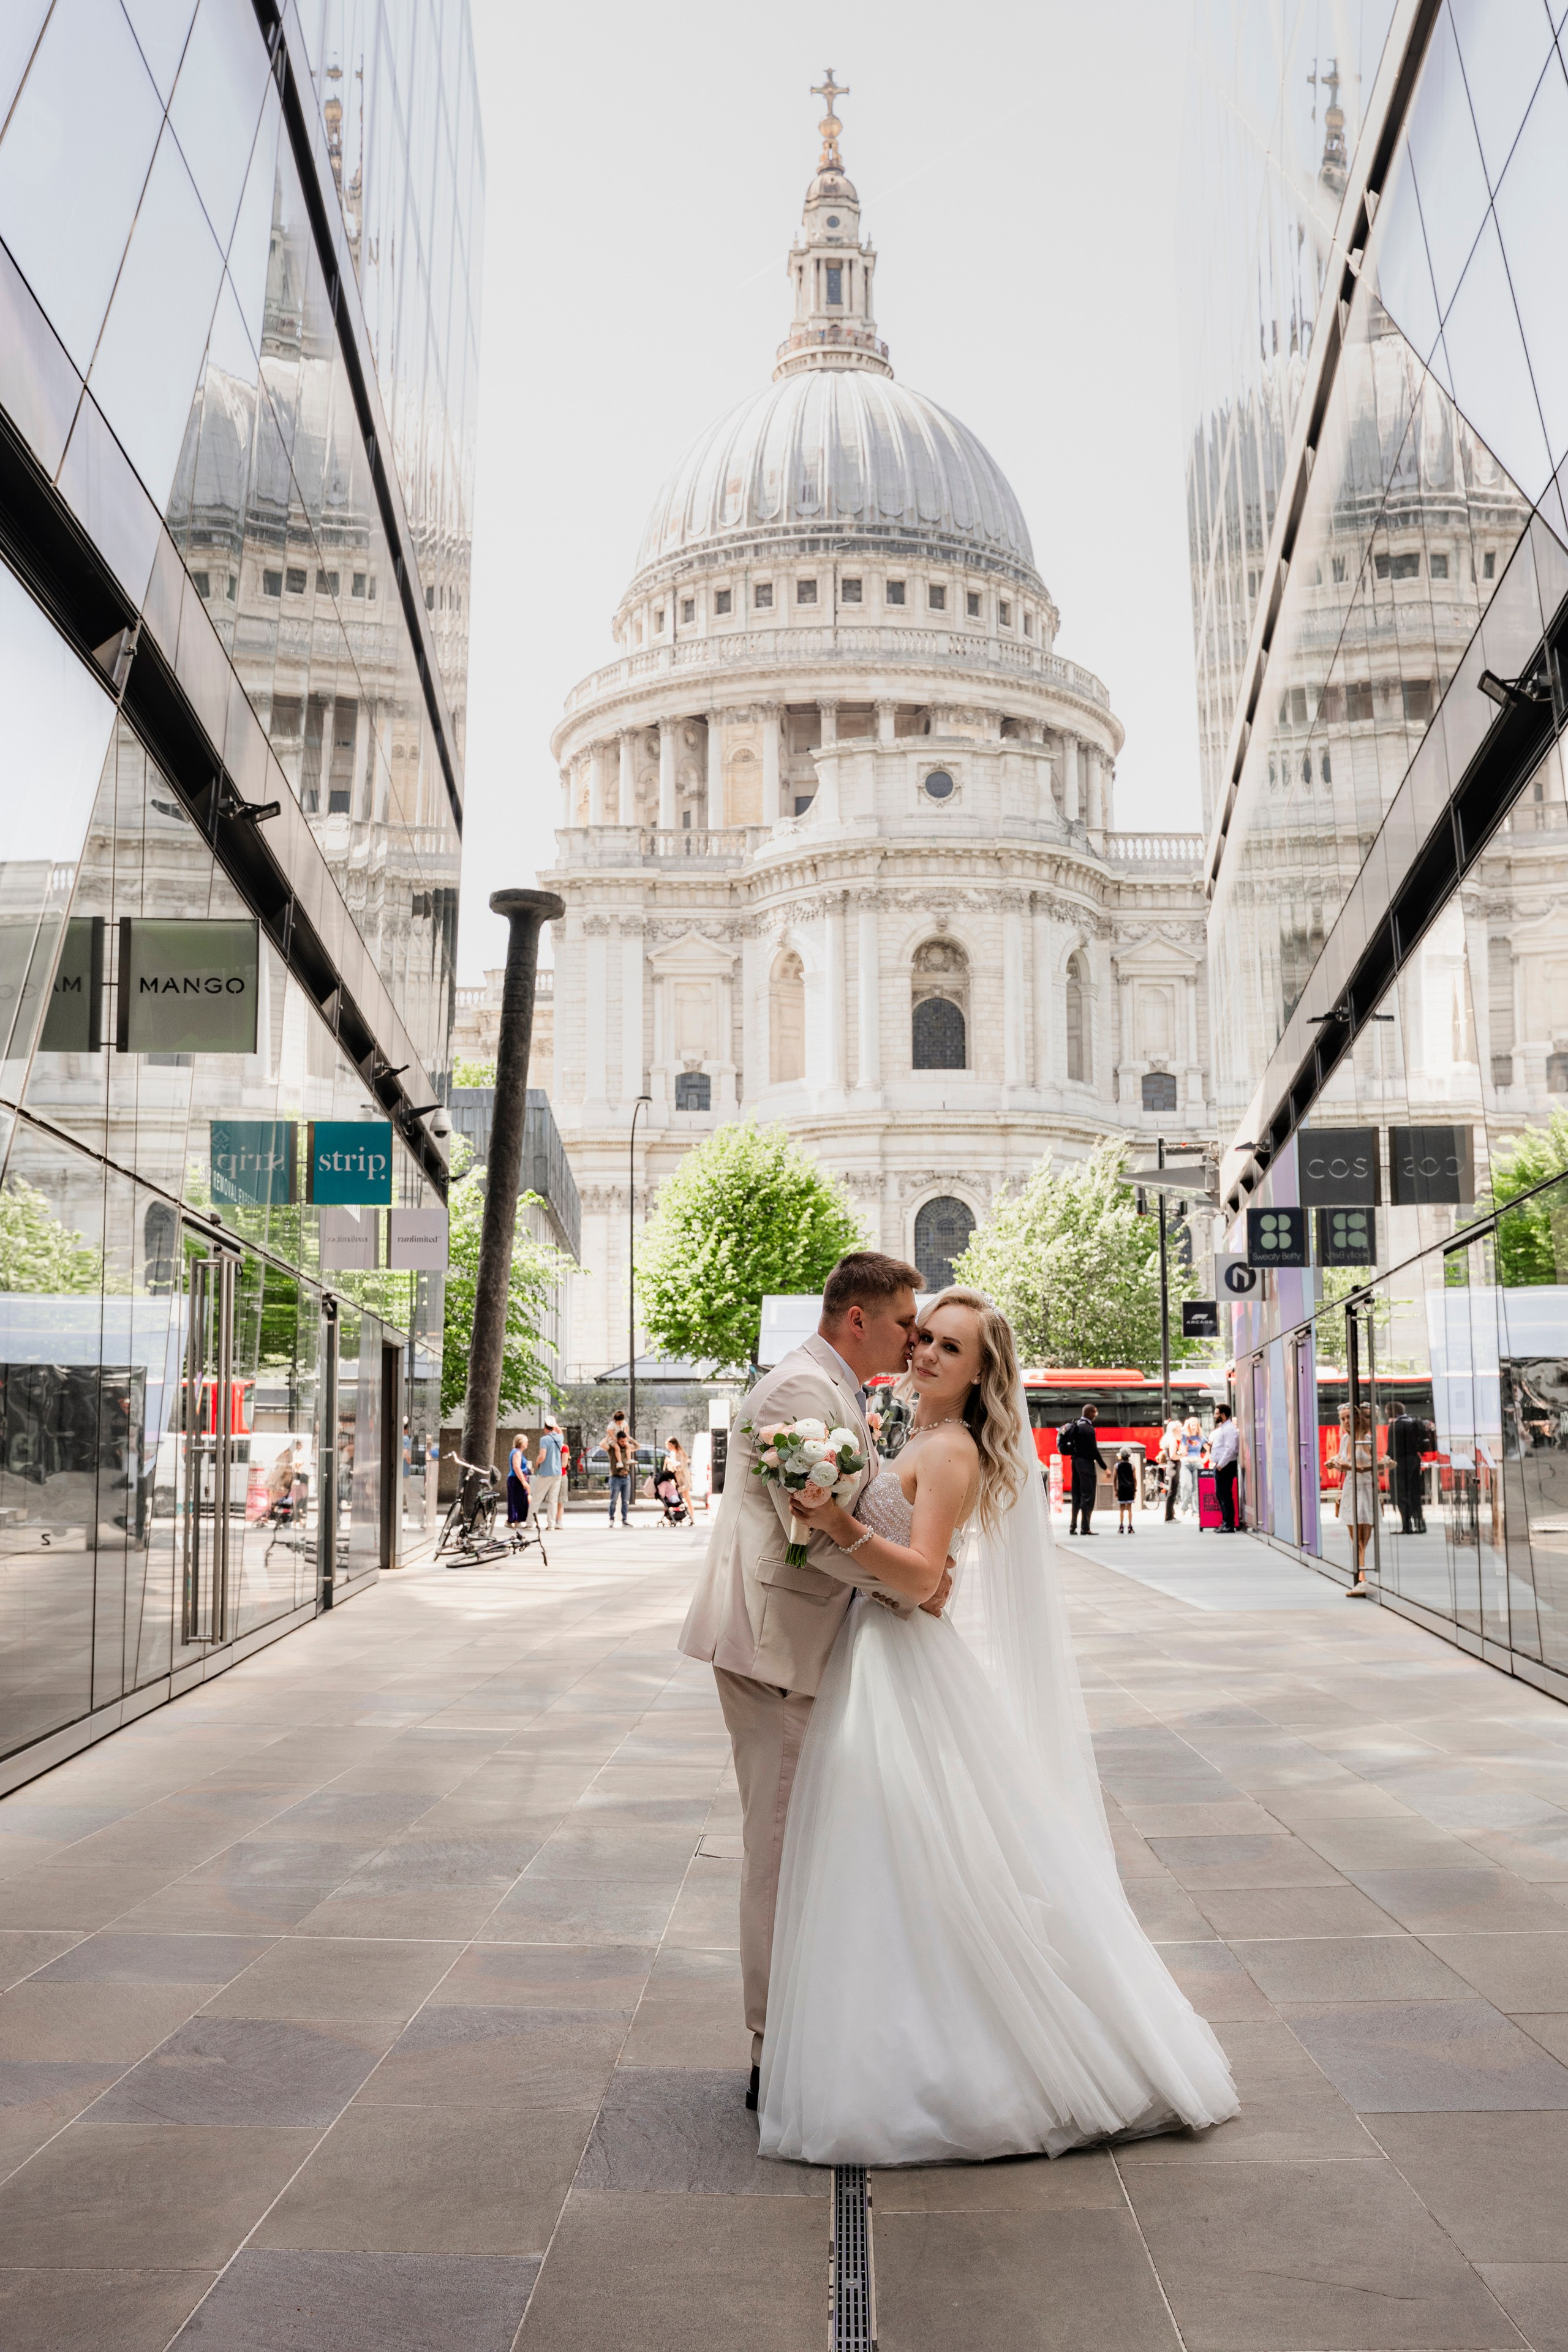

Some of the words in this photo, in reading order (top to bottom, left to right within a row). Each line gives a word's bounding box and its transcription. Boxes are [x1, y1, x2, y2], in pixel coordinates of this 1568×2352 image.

[139, 977, 245, 994] MANGO
[1306, 1158, 1368, 1179] COS
[1252, 1252, 1280, 1262] Sweaty
[1281, 1251, 1302, 1261] Betty
